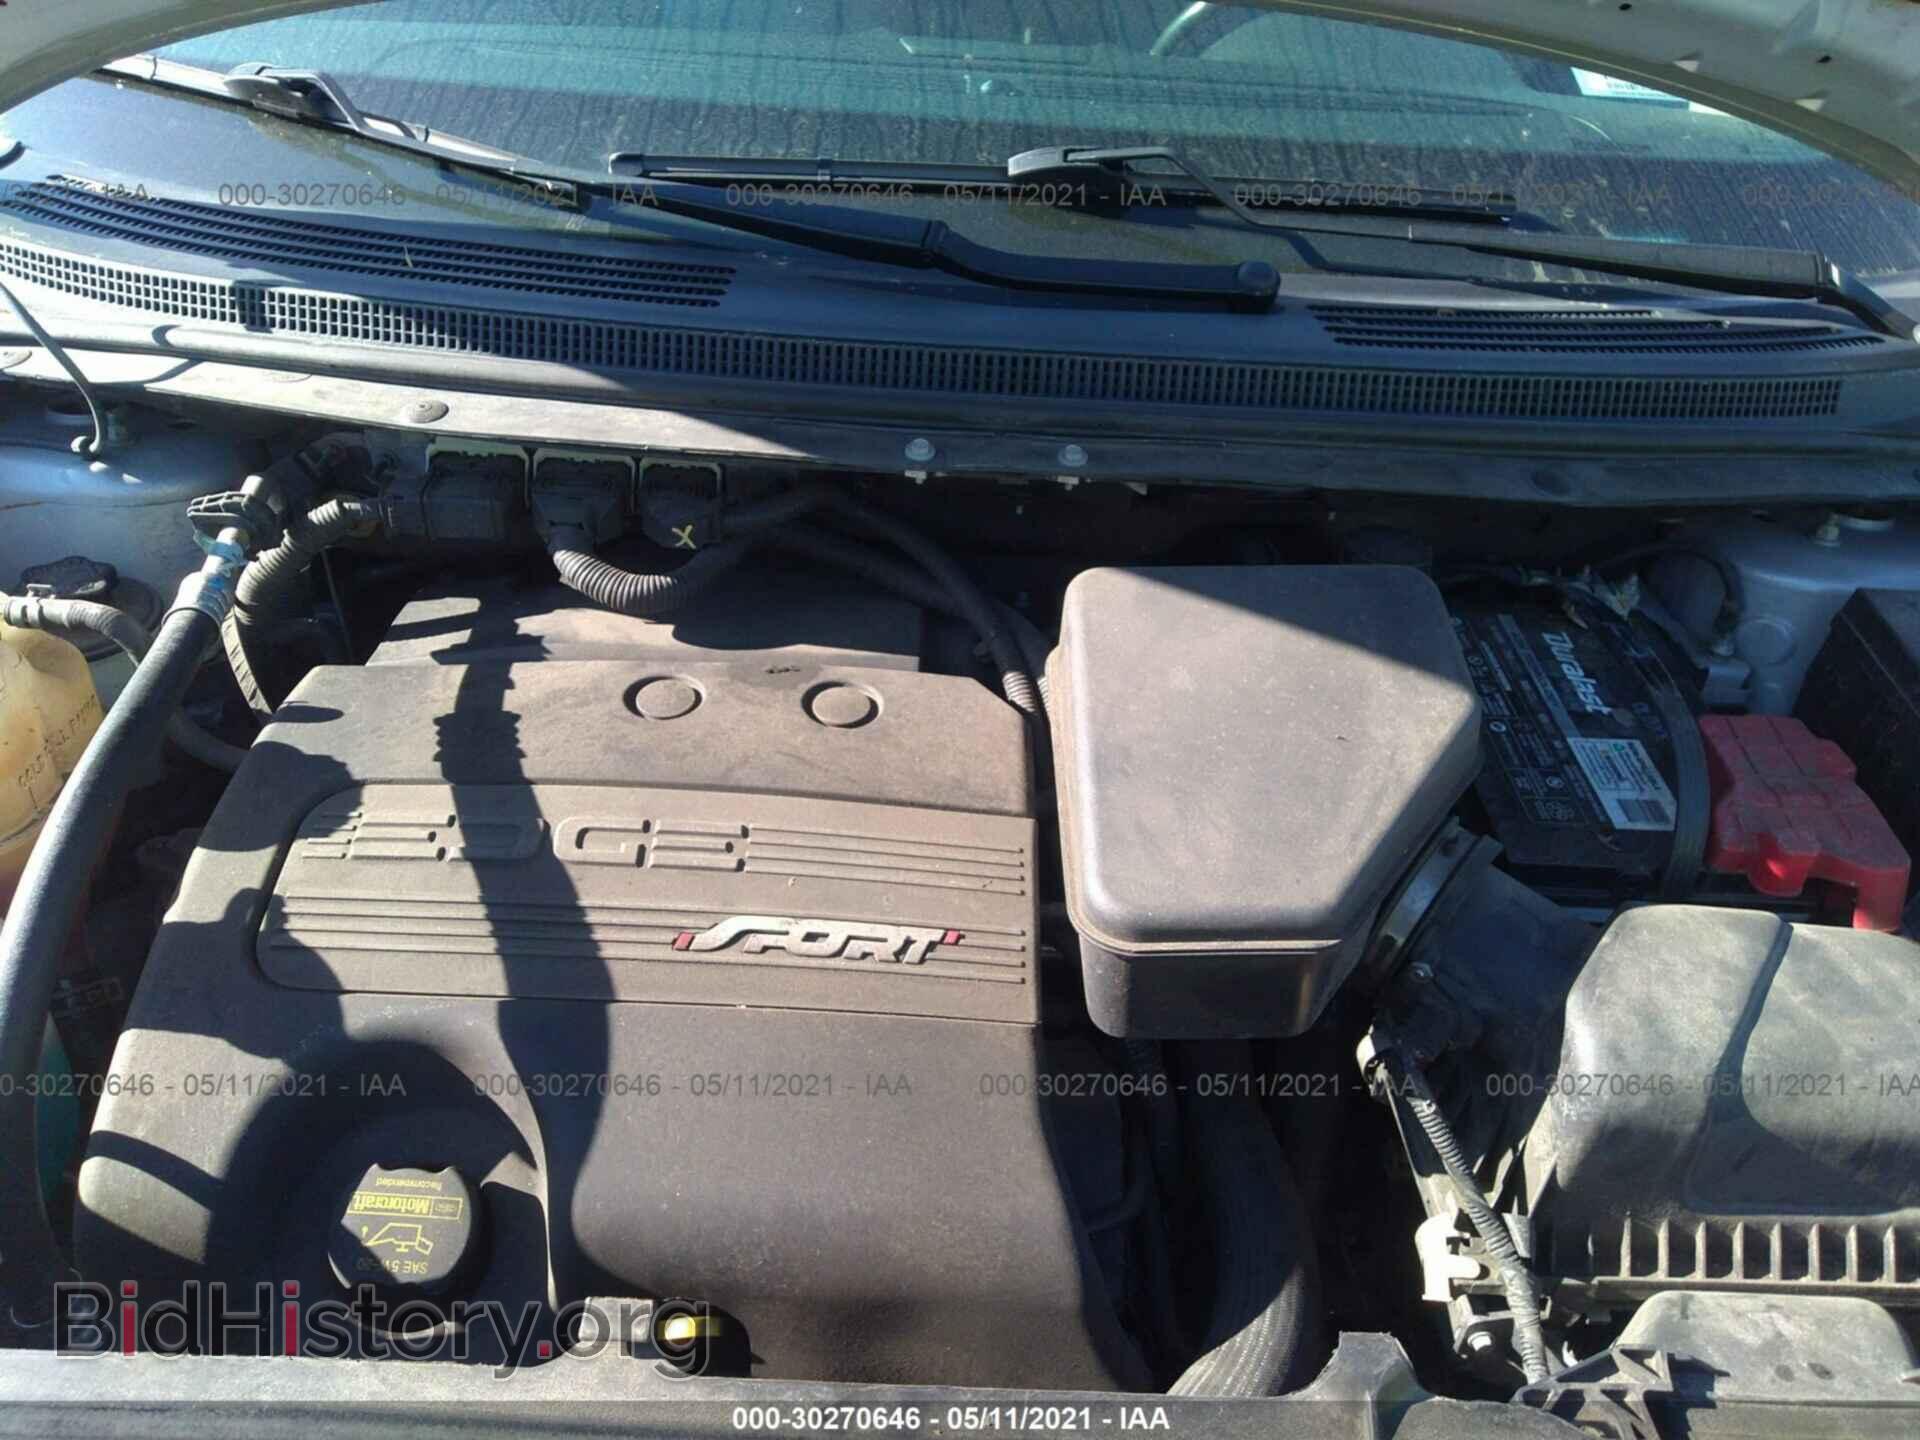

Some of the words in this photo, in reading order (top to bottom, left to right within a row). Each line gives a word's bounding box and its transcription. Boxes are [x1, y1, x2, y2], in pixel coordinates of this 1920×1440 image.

[1541, 631, 1614, 716] Duralast
[689, 914, 947, 966] SPORT
[353, 1193, 431, 1215] Motorcraft
[402, 1259, 429, 1275] SAE
